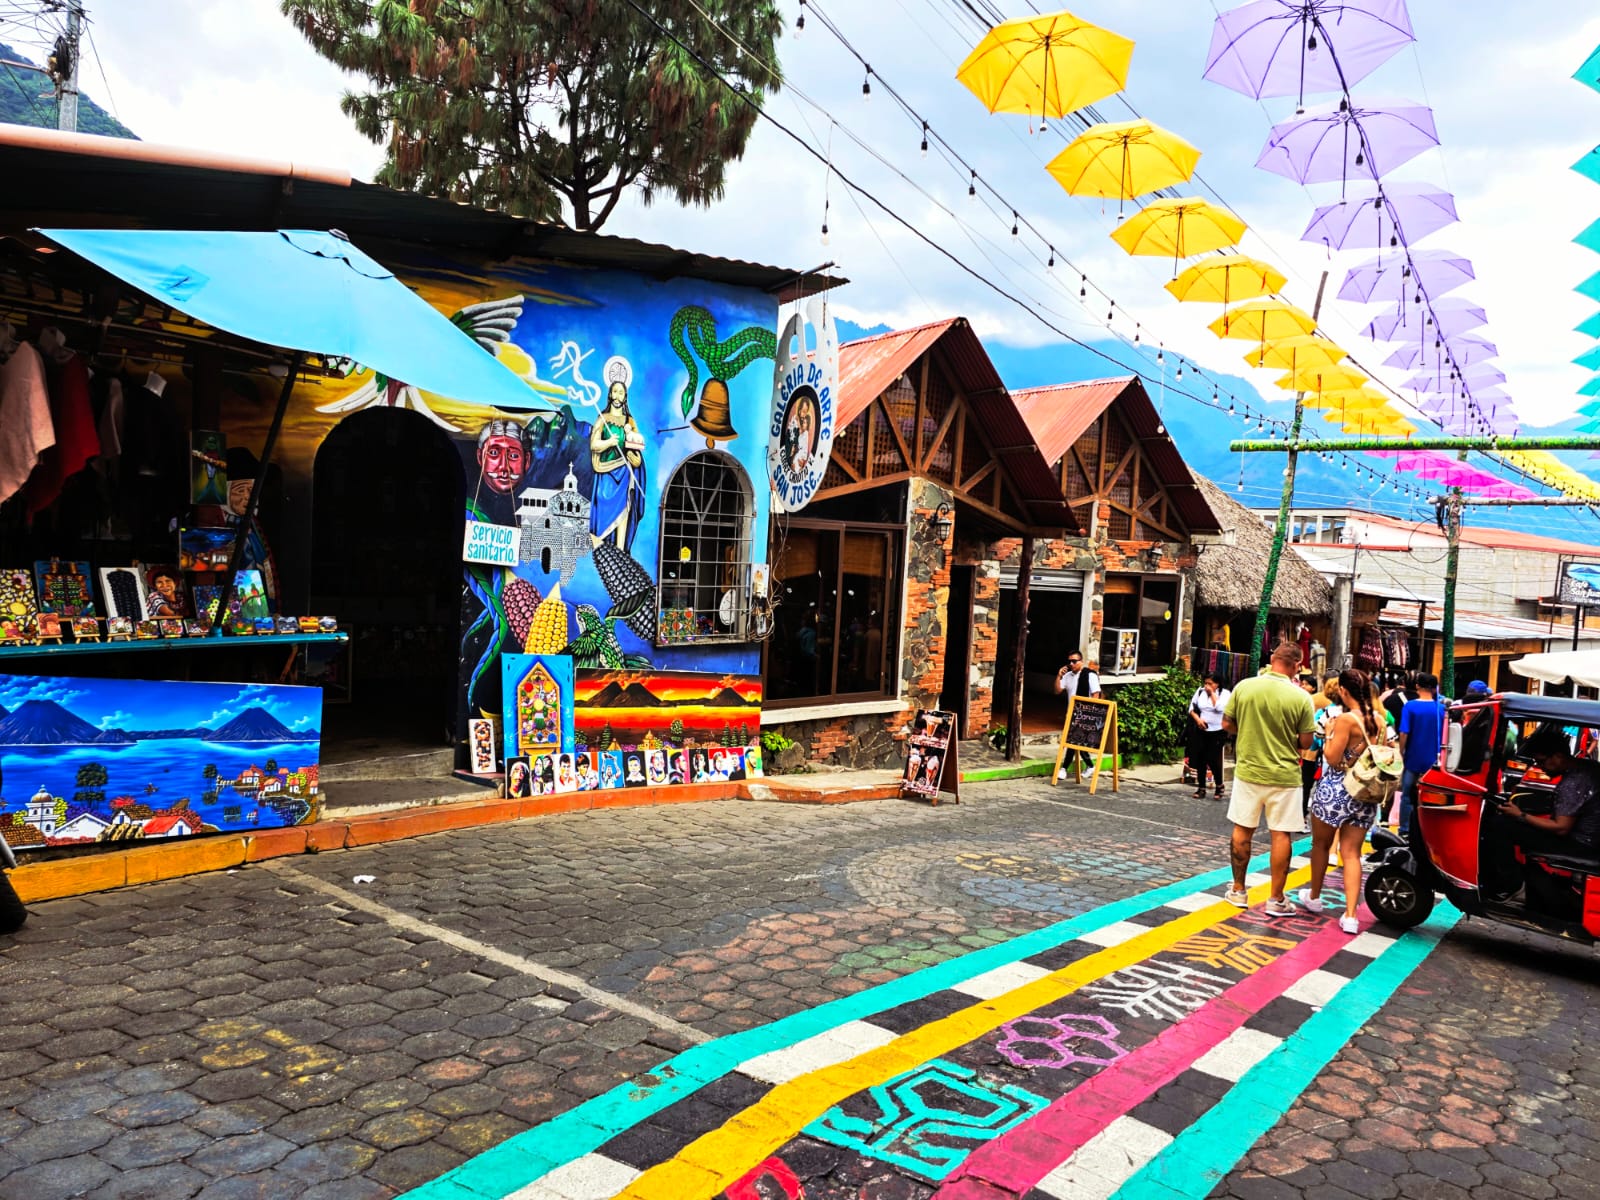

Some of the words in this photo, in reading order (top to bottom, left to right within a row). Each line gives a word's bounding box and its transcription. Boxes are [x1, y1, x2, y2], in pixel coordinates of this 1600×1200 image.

[771, 363, 804, 437] GALERIA
[807, 362, 822, 388] DE
[819, 386, 832, 440] ARTE
[773, 464, 790, 501] SAN
[472, 525, 512, 545] servicio
